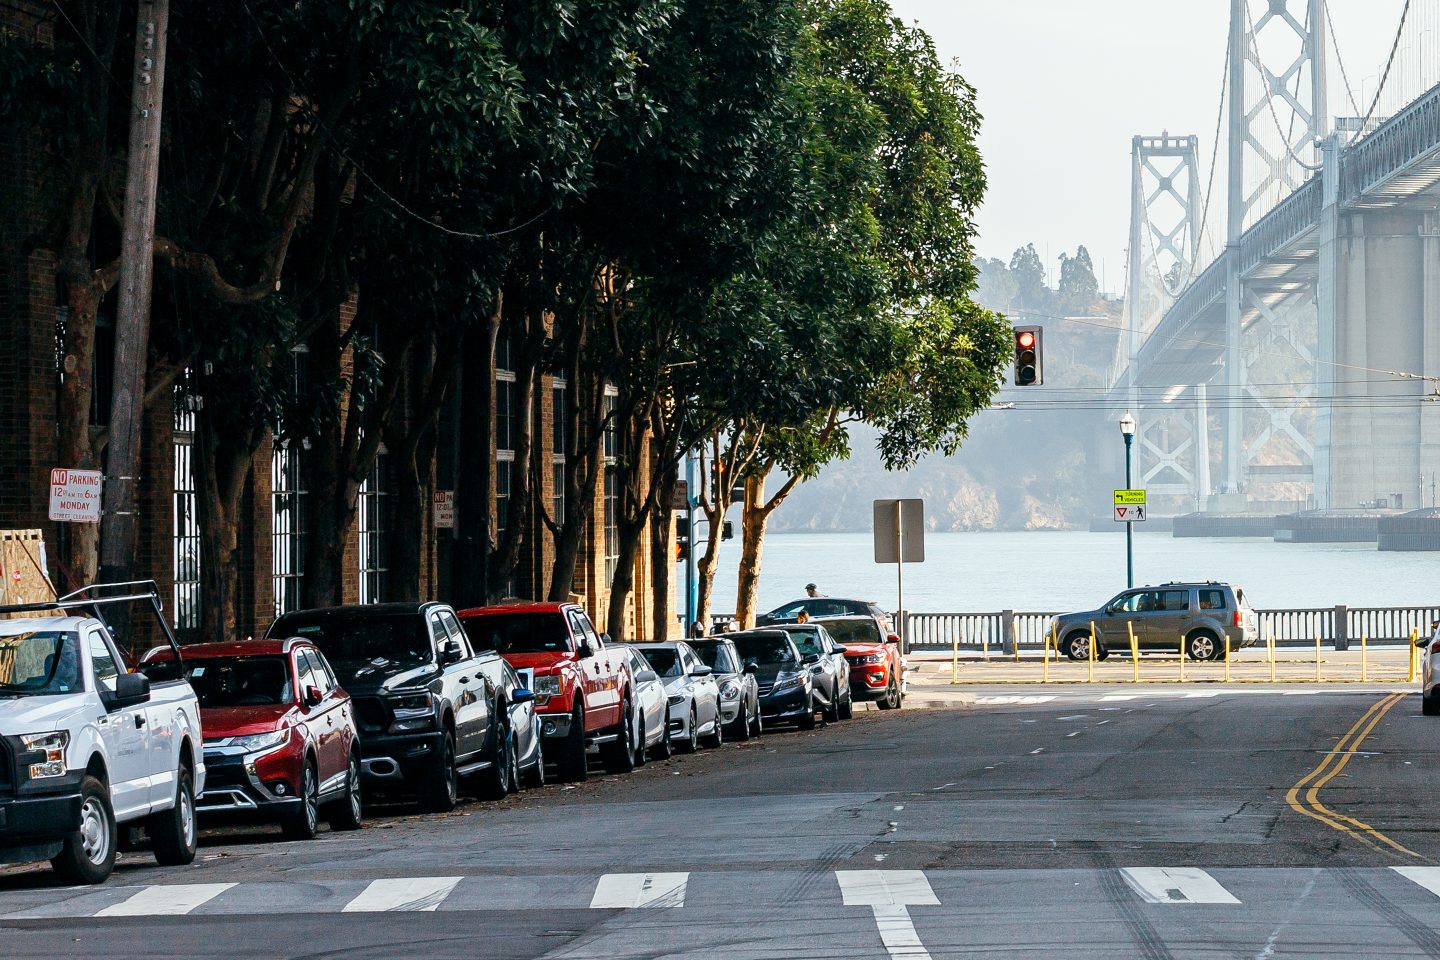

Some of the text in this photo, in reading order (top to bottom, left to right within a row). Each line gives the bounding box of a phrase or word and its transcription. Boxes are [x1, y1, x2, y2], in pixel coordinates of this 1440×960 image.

[53, 470, 99, 486] NO PARKING
[435, 492, 445, 501] NO
[60, 500, 90, 510] MONDAY
